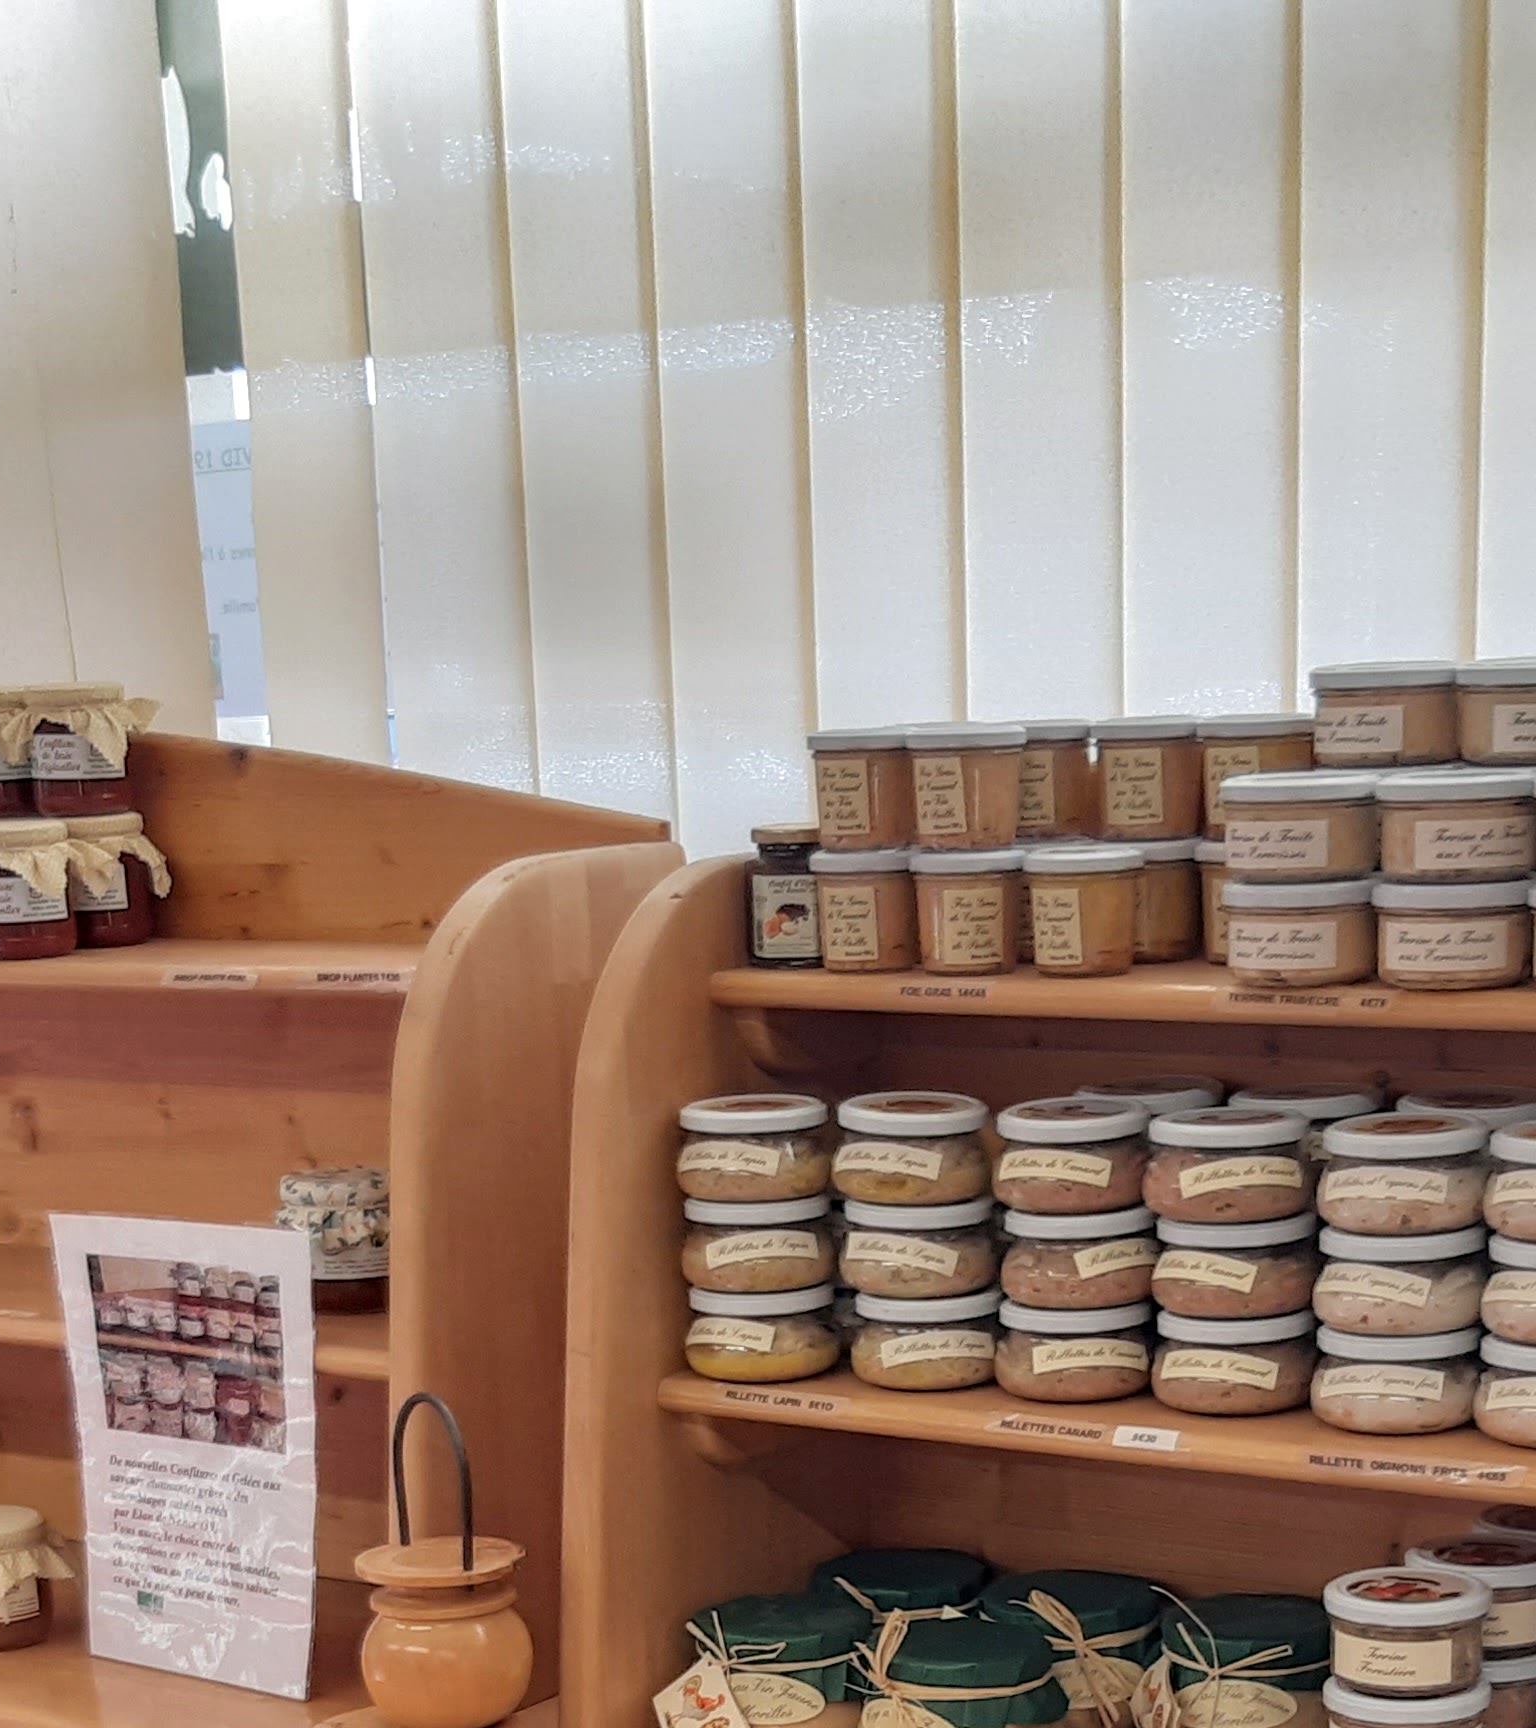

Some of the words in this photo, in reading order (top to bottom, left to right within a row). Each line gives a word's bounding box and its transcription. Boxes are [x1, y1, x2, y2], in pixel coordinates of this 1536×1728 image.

[725, 1390, 768, 1404] RILLETTE
[1000, 1419, 1055, 1436] RILLETTES
[1057, 1425, 1102, 1440] CANARD
[109, 1455, 123, 1466] De
[124, 1458, 167, 1472] nouvelles
[1309, 1454, 1364, 1470] RILLETTE
[1370, 1460, 1426, 1476] OIGNONS
[175, 1533, 199, 1547] choix
